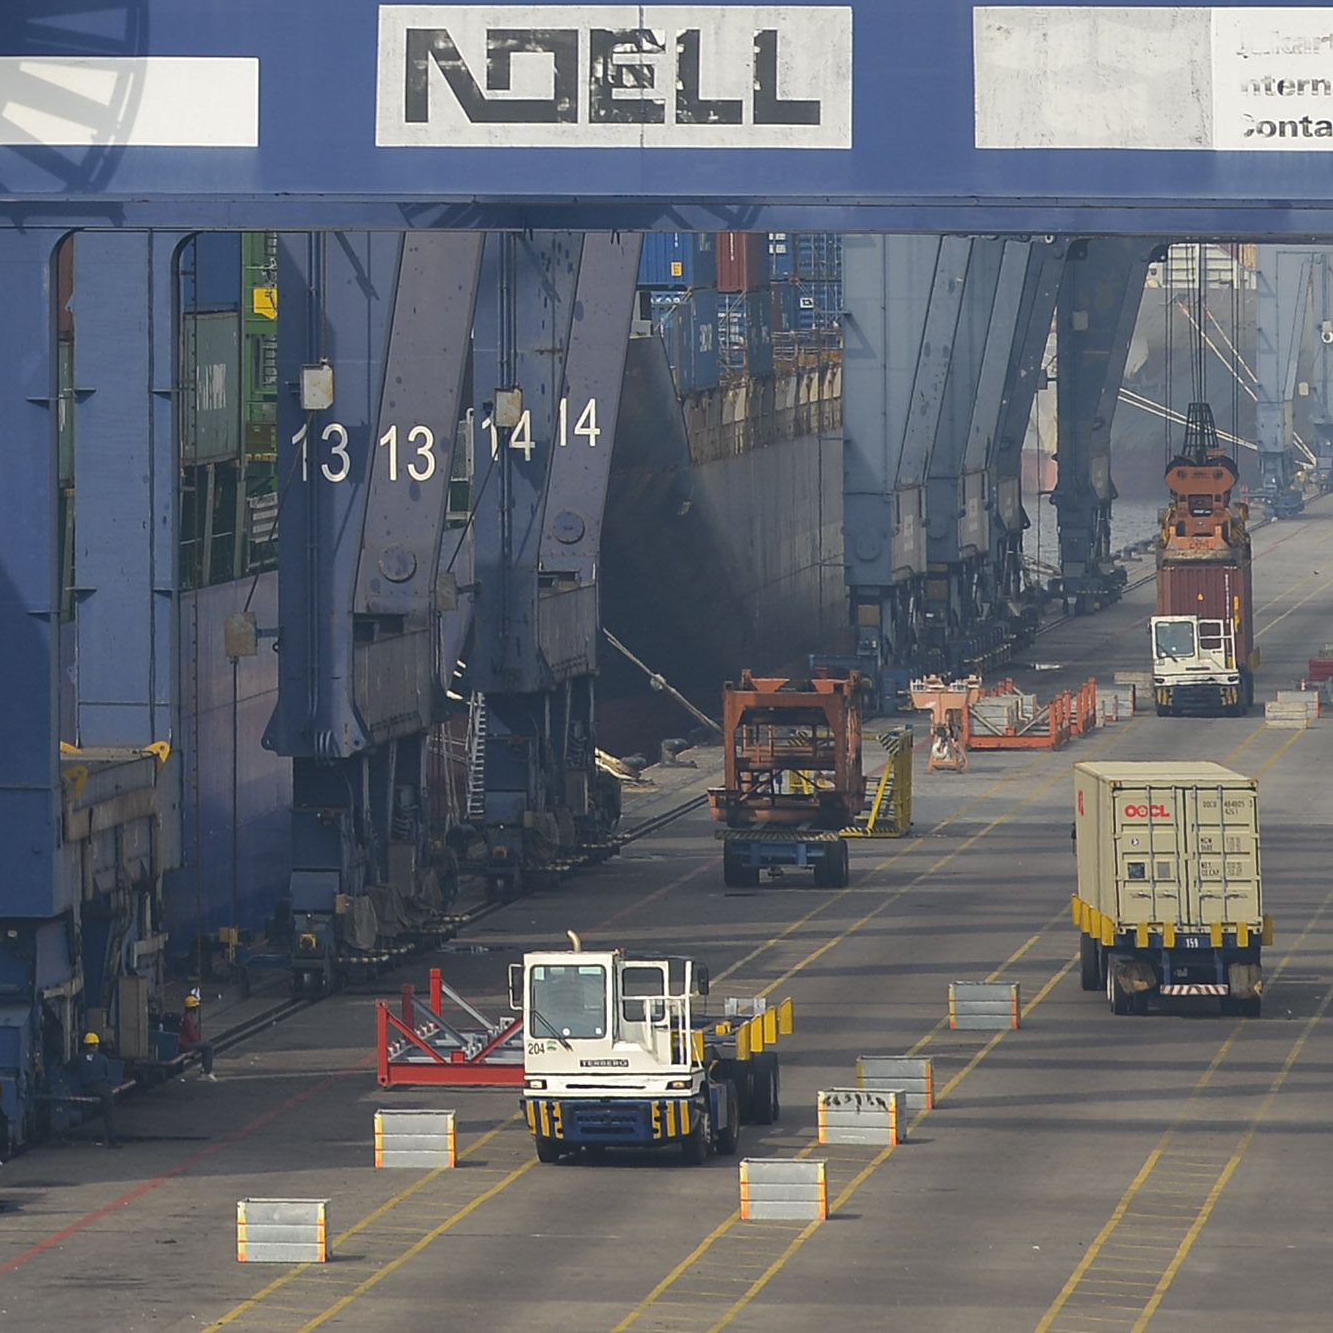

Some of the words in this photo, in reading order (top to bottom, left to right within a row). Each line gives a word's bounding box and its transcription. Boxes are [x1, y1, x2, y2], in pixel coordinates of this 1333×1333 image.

[405, 27, 821, 125] NOELL
[559, 397, 601, 447] 14
[291, 422, 351, 483] 13
[379, 424, 437, 482] 13
[1125, 804, 1170, 818] OOCL
[528, 1043, 545, 1055] 204
